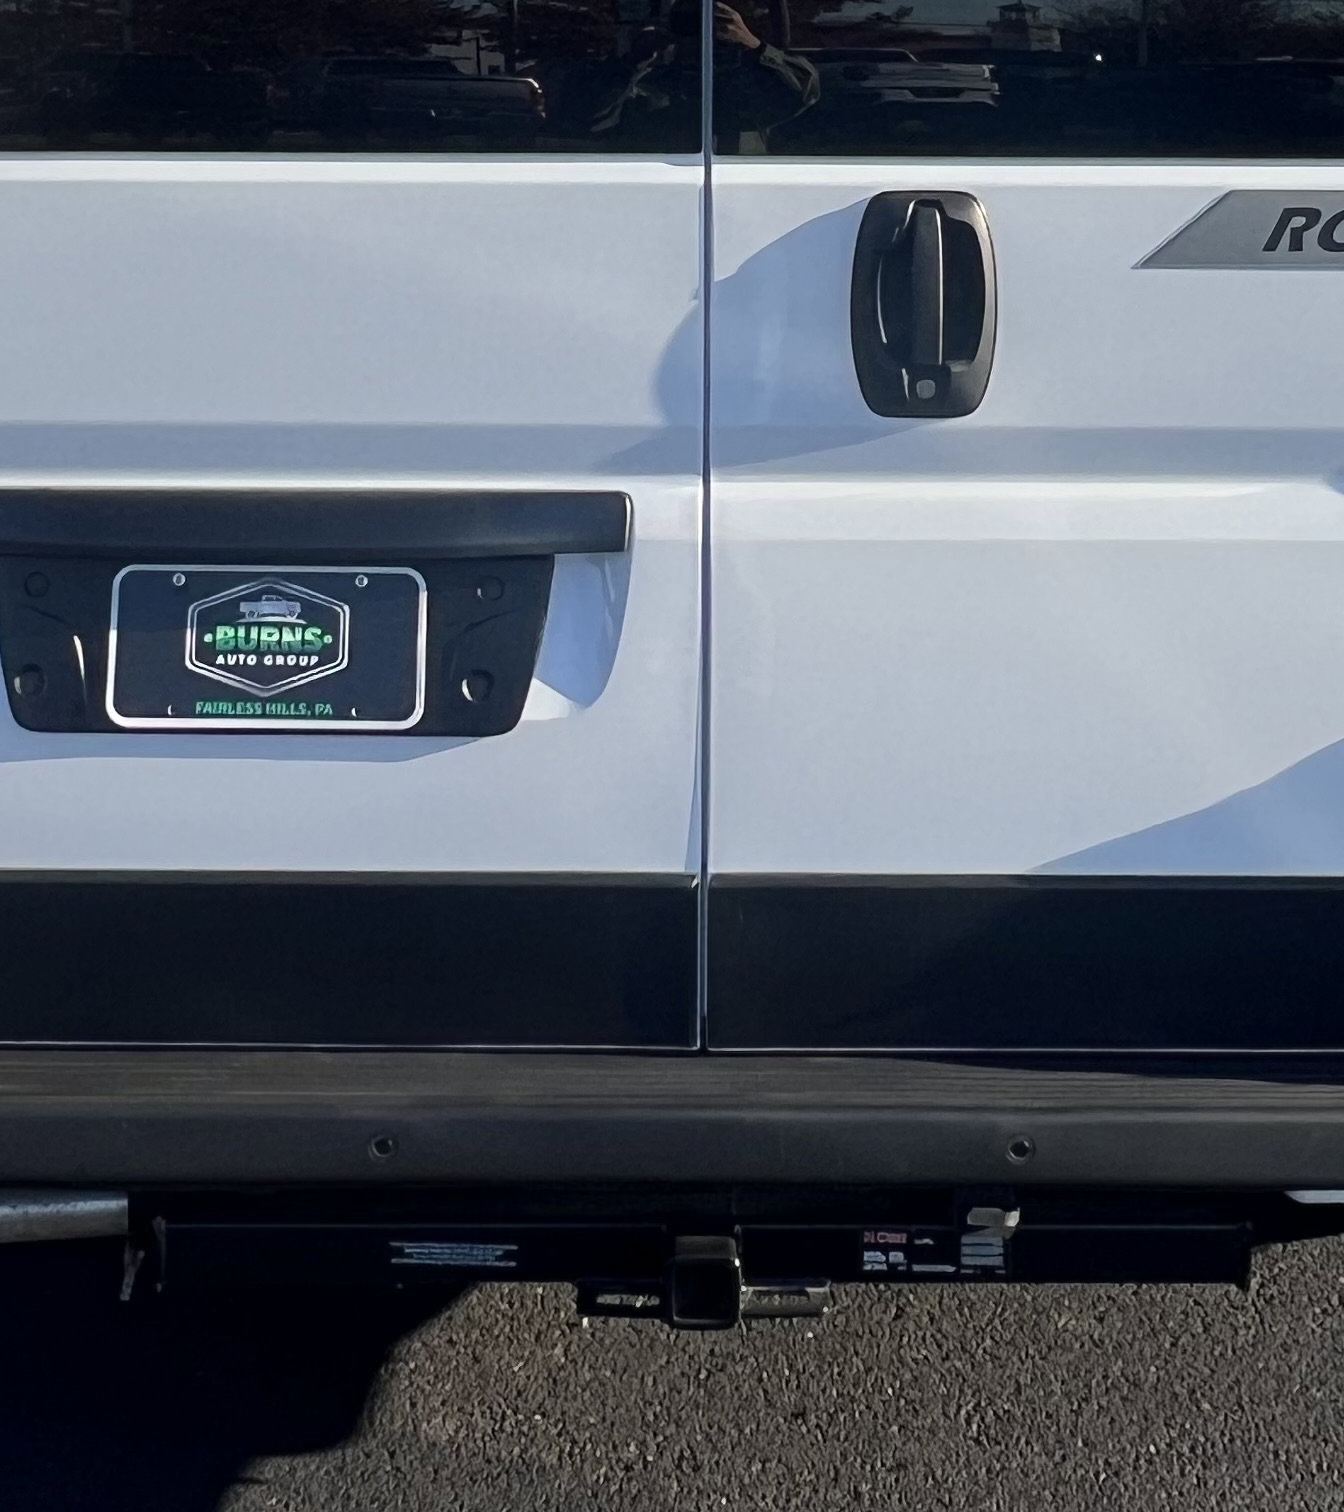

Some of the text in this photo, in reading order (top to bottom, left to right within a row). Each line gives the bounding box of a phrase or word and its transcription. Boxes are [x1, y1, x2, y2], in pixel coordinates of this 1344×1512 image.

[215, 625, 323, 652] BURNS
[216, 654, 319, 667] AUTO GROUP
[196, 701, 262, 716] FAIRLESS
[315, 703, 333, 716] PA
